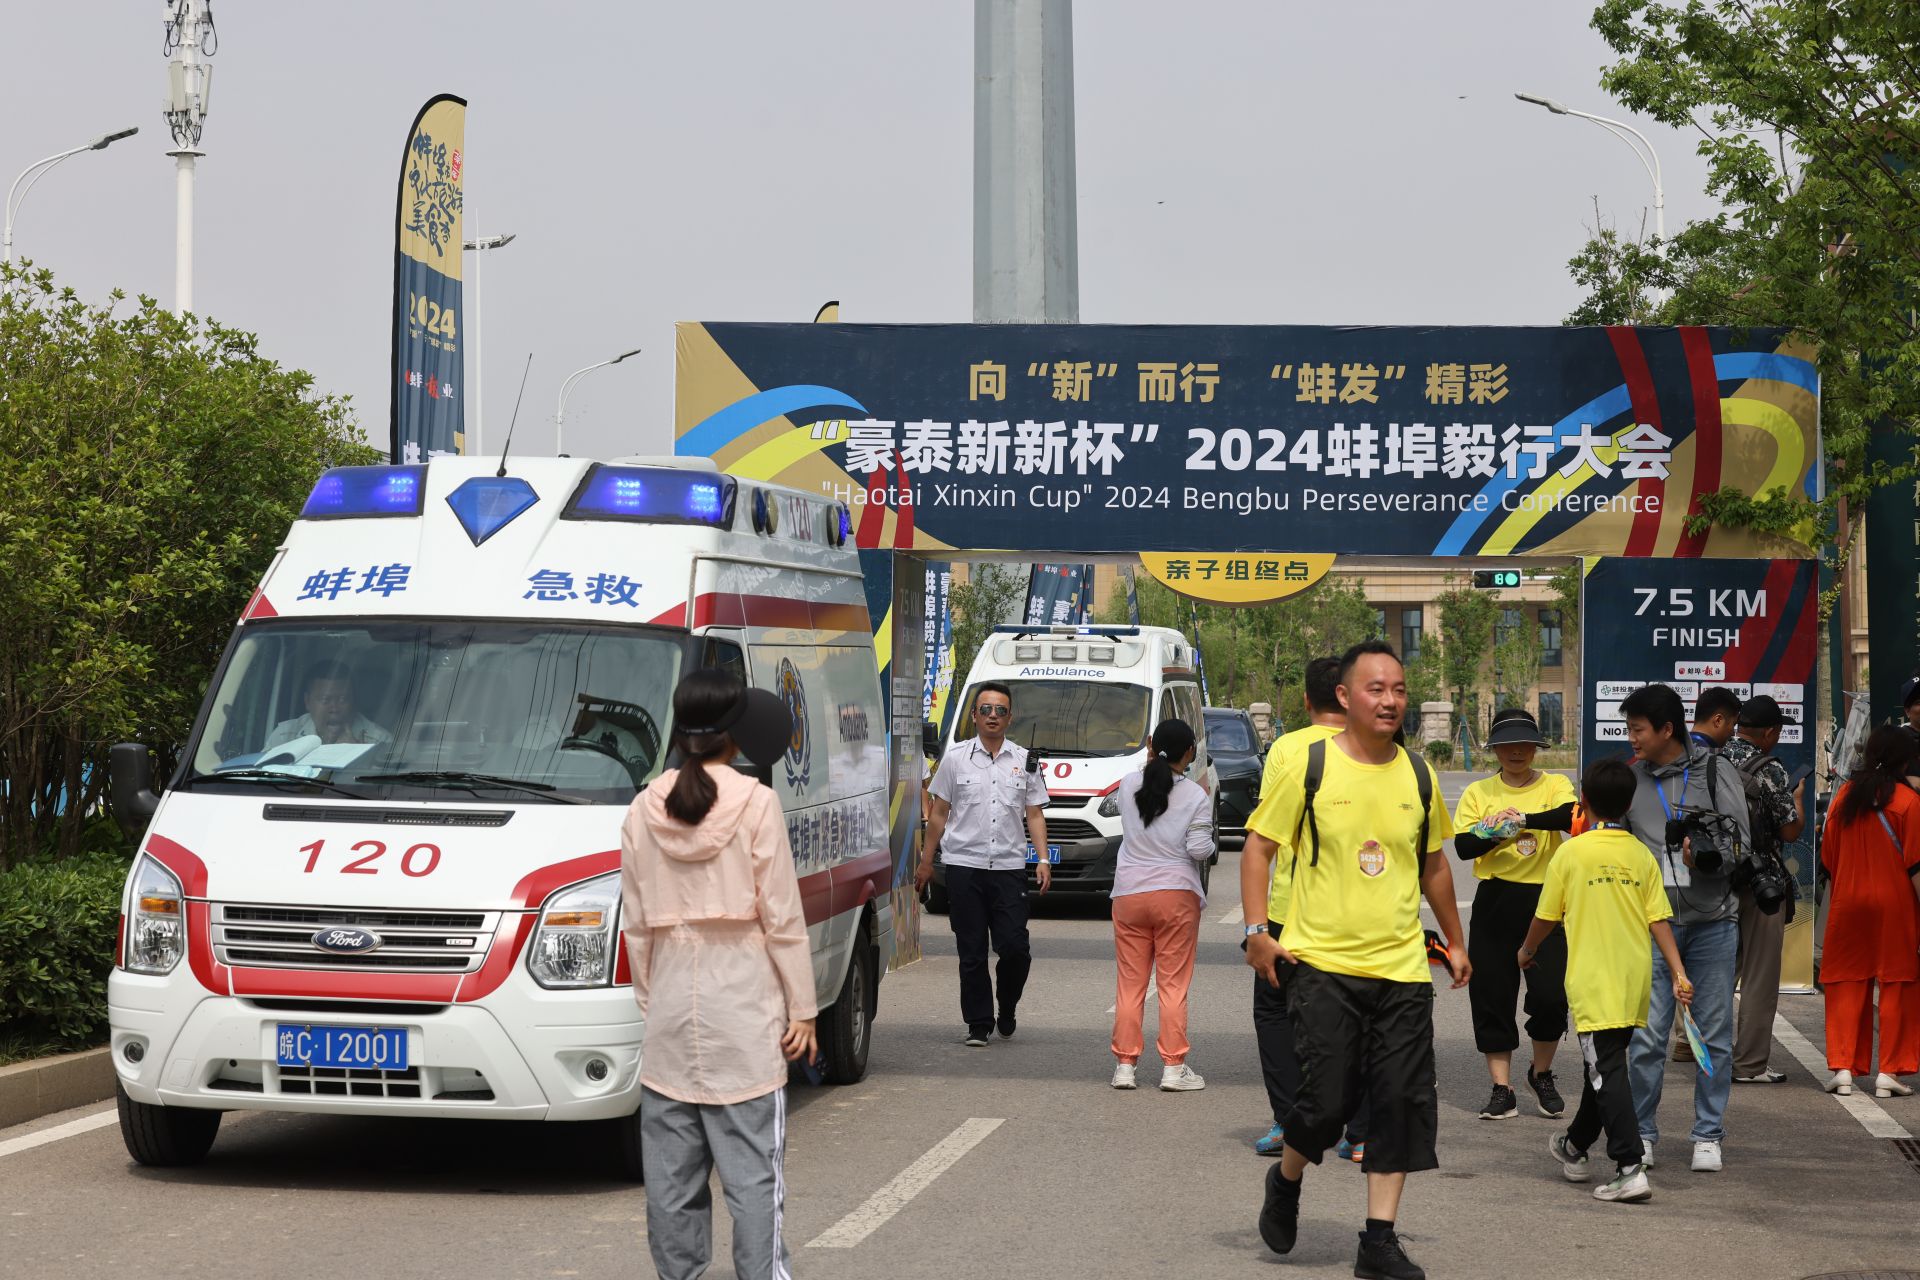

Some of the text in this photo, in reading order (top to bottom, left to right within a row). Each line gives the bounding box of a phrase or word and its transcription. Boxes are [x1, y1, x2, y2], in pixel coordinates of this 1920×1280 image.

[969, 361, 1007, 401] 向
[1137, 362, 1222, 403] 而行
[1425, 363, 1511, 405] 精彩
[933, 483, 1017, 508] Xinxin
[1104, 485, 1171, 510] 2024
[1183, 487, 1290, 515] Bengbu
[1302, 488, 1489, 514] Perseverance
[1501, 489, 1661, 515] Conference
[789, 498, 812, 542] 120
[296, 562, 644, 608] 蚌埠 急救
[1166, 560, 1310, 581] 亲子组终点
[1633, 588, 1767, 618] 7.5 KM
[1653, 628, 1740, 647] FINISH
[1019, 666, 1106, 678] Ambulance
[838, 704, 868, 743] Ambulance
[1603, 728, 1622, 736] NIO
[297, 838, 442, 878] 120
[325, 929, 363, 947] Ford
